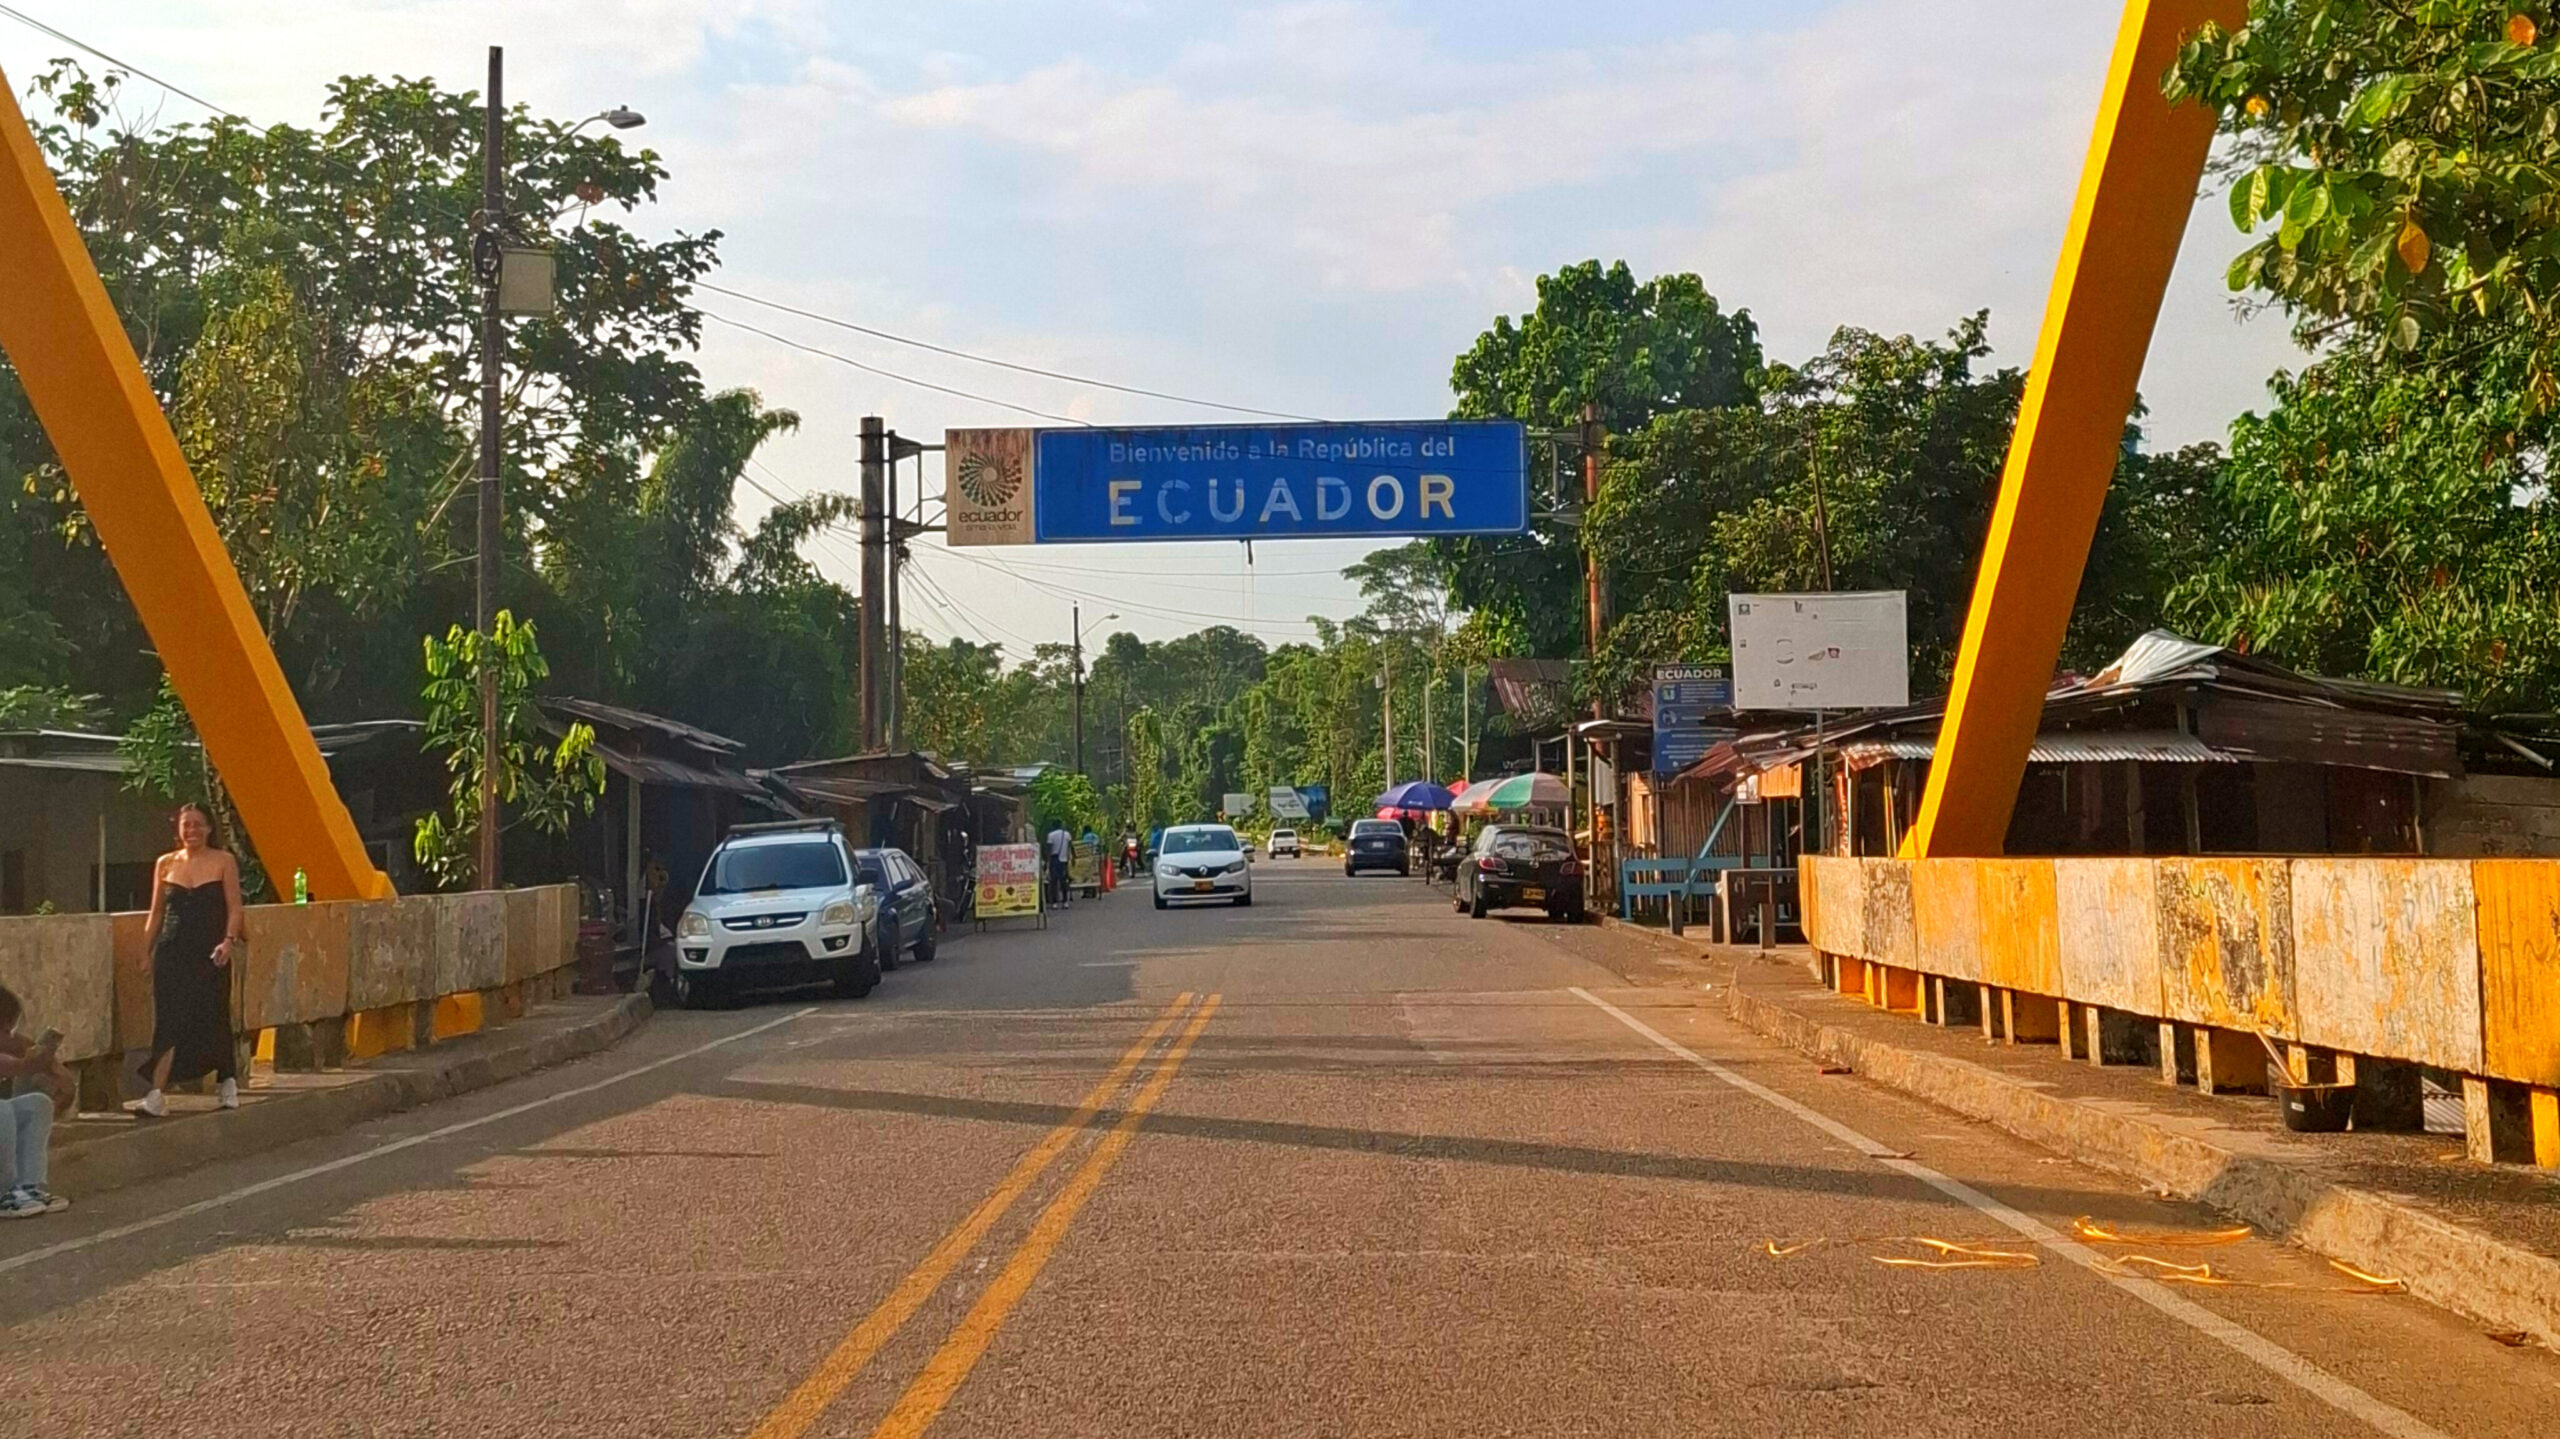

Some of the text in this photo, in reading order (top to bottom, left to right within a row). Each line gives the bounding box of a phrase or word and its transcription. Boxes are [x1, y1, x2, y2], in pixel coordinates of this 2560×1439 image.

[1109, 436, 1455, 463] Bienvenido a la República del
[1108, 474, 1456, 526] ECUADOR
[958, 508, 1024, 523] ecuador
[1656, 668, 1722, 680] ECUADOR
